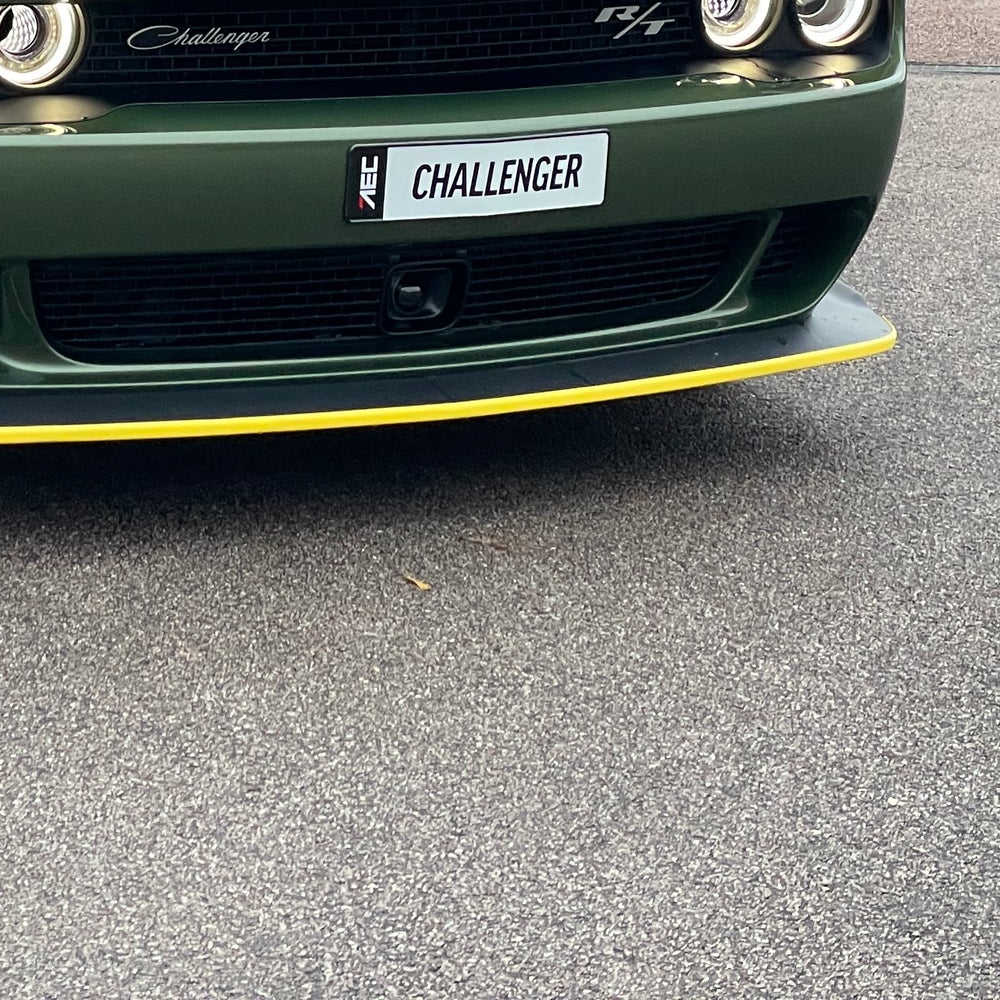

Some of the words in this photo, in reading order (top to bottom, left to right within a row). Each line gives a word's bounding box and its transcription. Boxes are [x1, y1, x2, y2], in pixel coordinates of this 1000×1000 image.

[127, 25, 270, 51] Challenger
[594, 1, 675, 39] R/T
[358, 155, 379, 210] AEC
[412, 154, 583, 200] CHALLENGER
